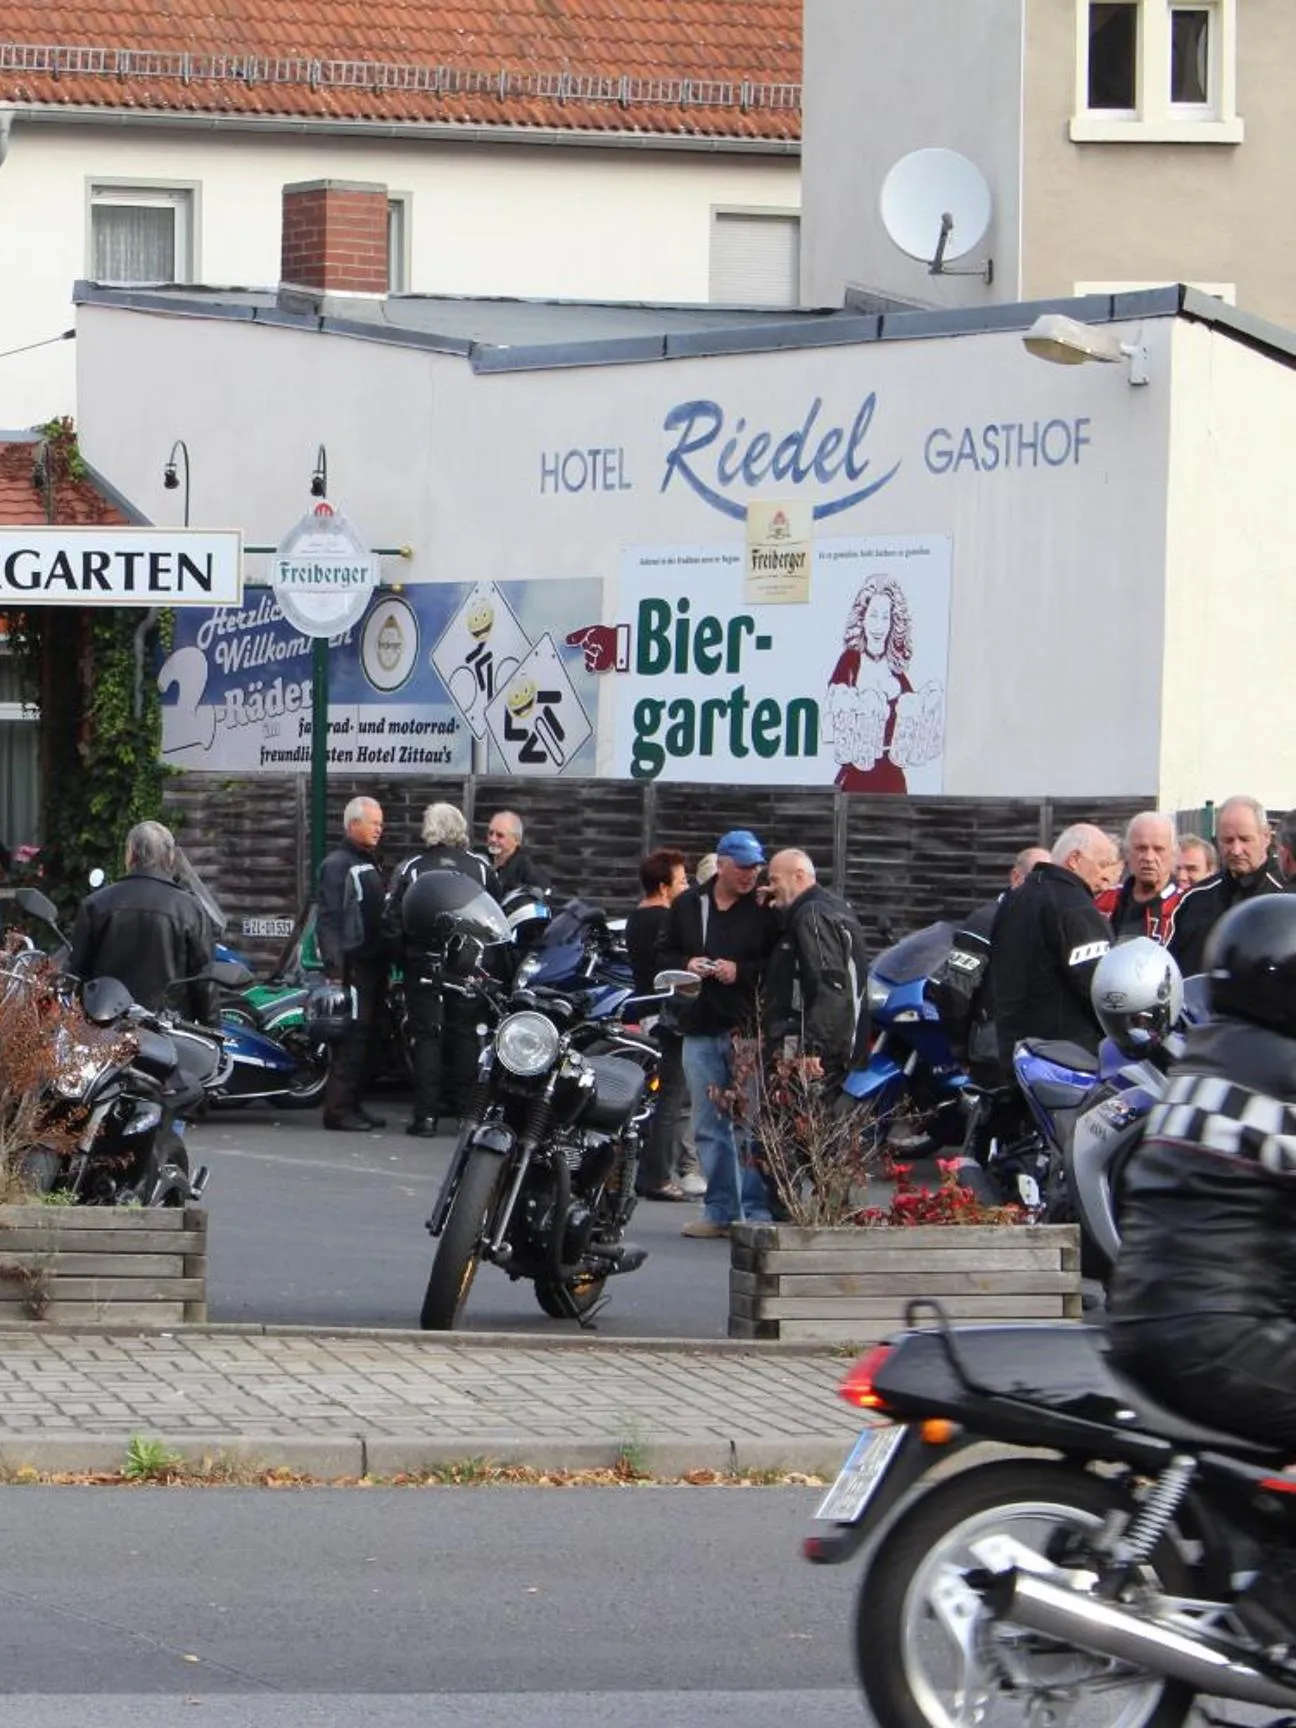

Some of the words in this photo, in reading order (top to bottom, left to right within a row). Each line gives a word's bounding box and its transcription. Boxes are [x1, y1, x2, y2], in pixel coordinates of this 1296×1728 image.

[540, 448, 632, 495] HOTEL
[659, 391, 876, 494] Riedel
[924, 417, 1091, 475] GASTHOF
[279, 561, 369, 588] Freiberger
[751, 548, 806, 574] Freiberger
[197, 595, 285, 650] Herzlic
[636, 597, 772, 675] Bier-
[215, 628, 352, 675] Willkomen
[298, 718, 354, 738] farad-
[358, 717, 385, 734] und
[388, 717, 461, 735] motorrad-
[630, 684, 819, 779] garten
[260, 746, 353, 766] freundlisten
[356, 745, 395, 764] Hotel
[399, 745, 453, 764] Zittau's
